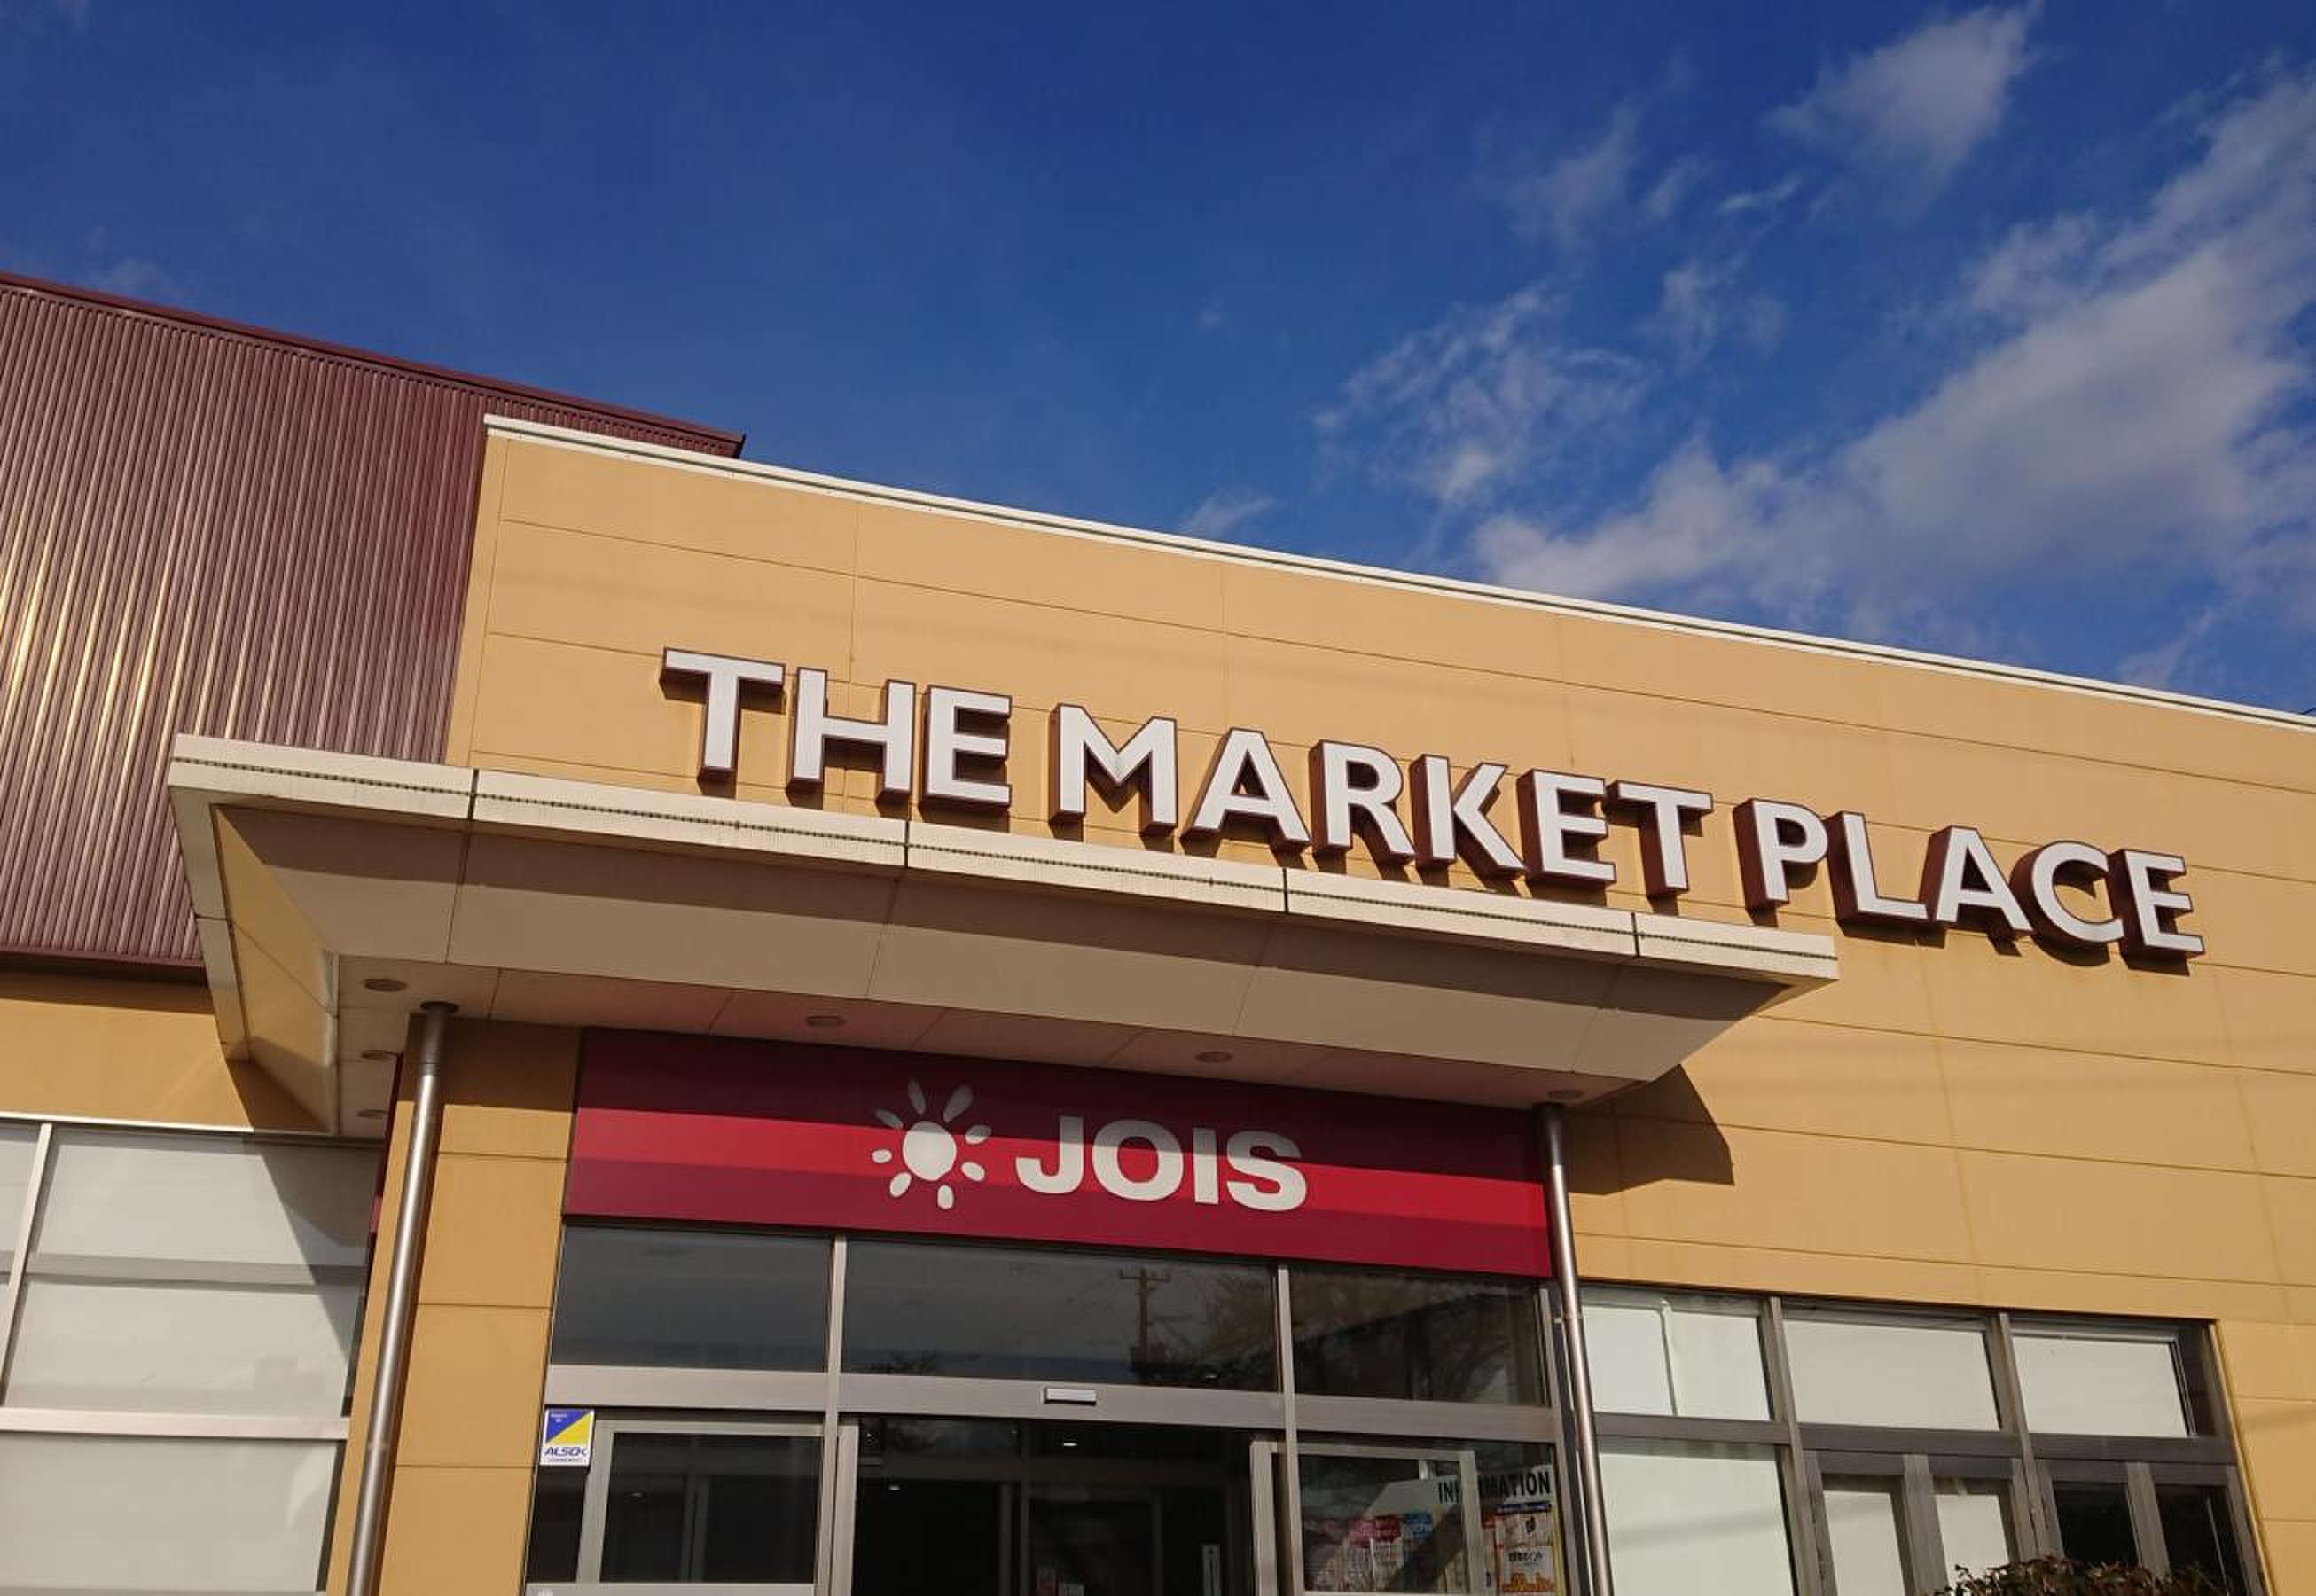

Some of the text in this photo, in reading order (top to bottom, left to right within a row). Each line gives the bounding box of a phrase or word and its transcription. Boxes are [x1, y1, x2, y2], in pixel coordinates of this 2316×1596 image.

[661, 646, 2205, 959] THE MARKET PLACE
[1015, 1115, 1308, 1212] JOIS
[544, 1446, 588, 1457] ALSOK
